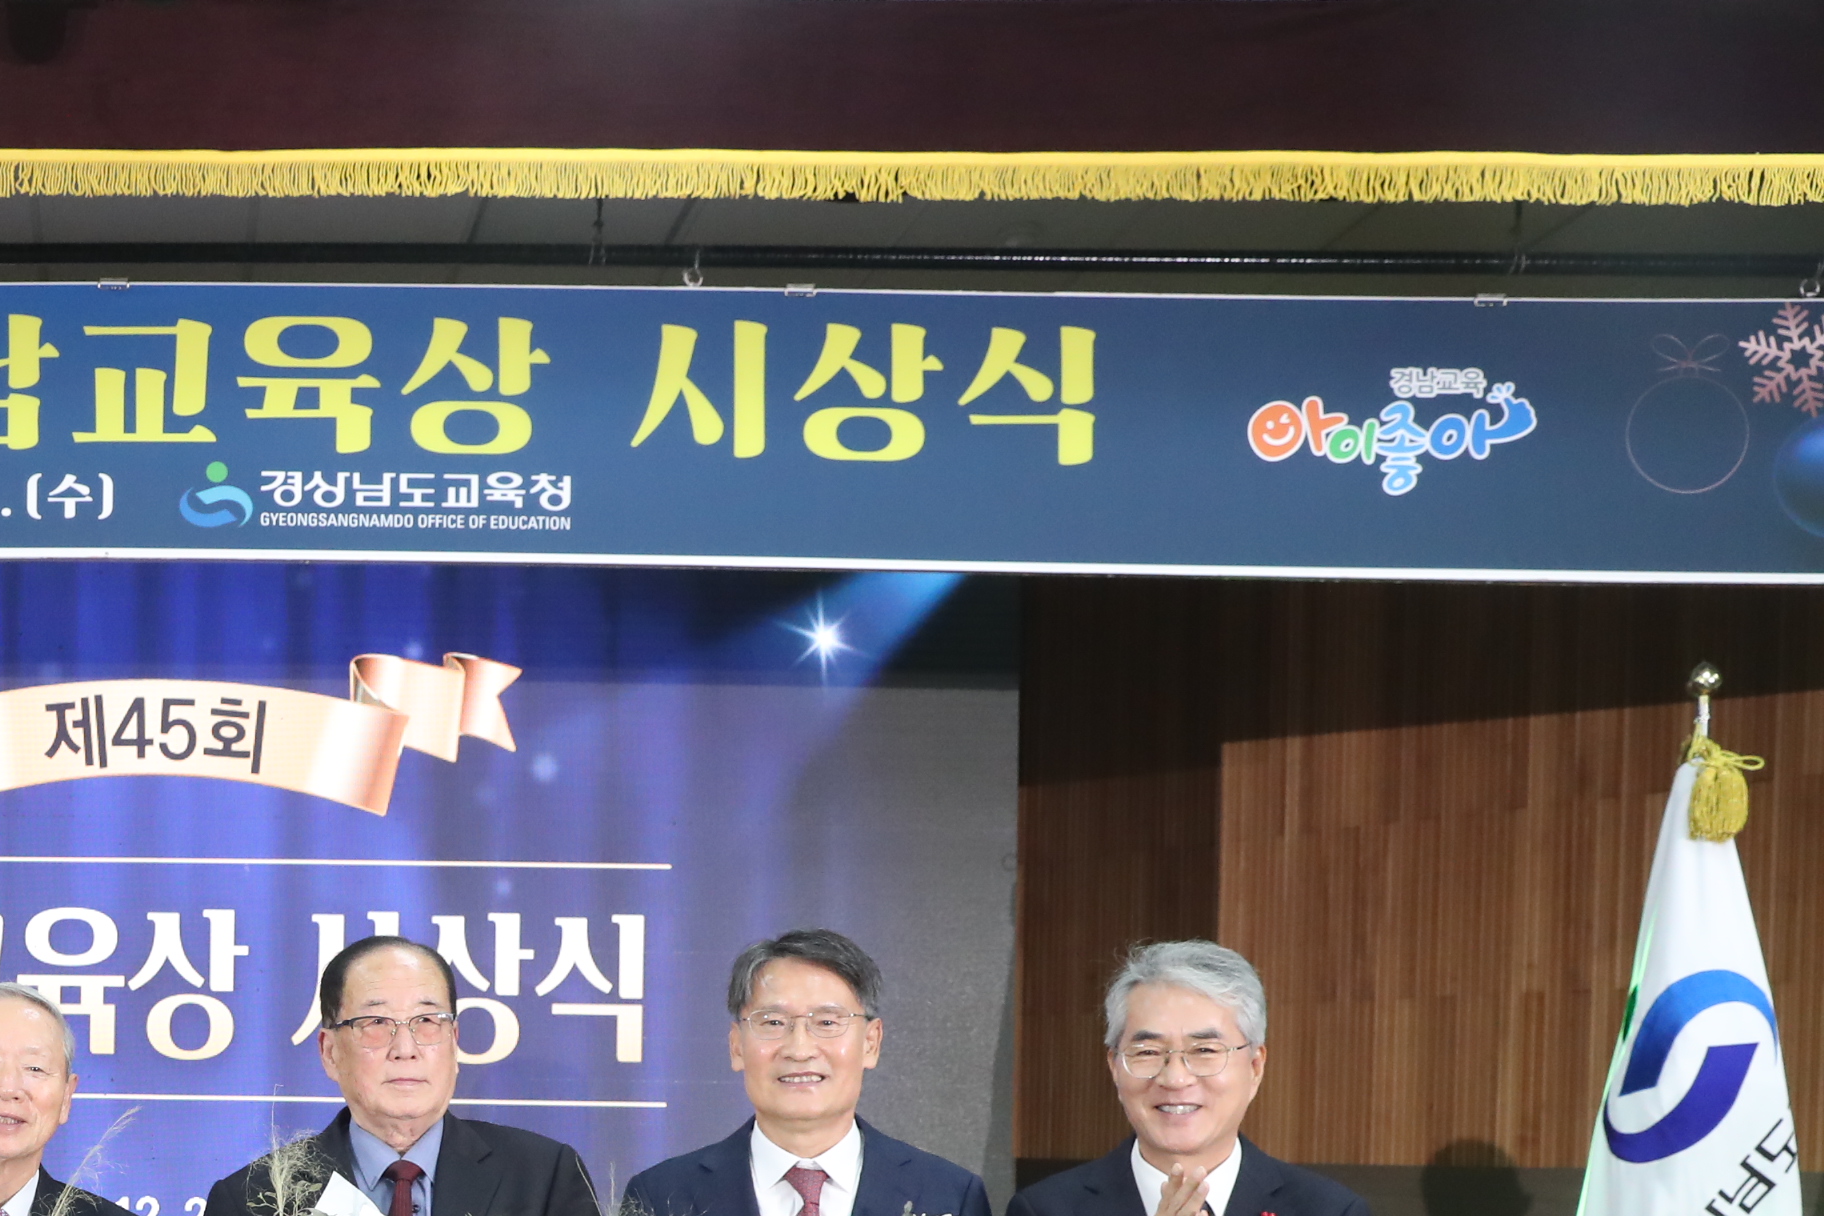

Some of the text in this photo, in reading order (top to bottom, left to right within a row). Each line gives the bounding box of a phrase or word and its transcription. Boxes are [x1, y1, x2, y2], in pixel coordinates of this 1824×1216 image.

[631, 319, 1097, 466] 시상식
[1390, 367, 1486, 398] 경남교육
[1247, 395, 1537, 496] 아이좋아
[260, 470, 572, 512] 경상남도교육청
[260, 511, 572, 531] GYEONGSANGNAMDO OFFICE OF EDUCATION
[44, 694, 268, 774] 제45회
